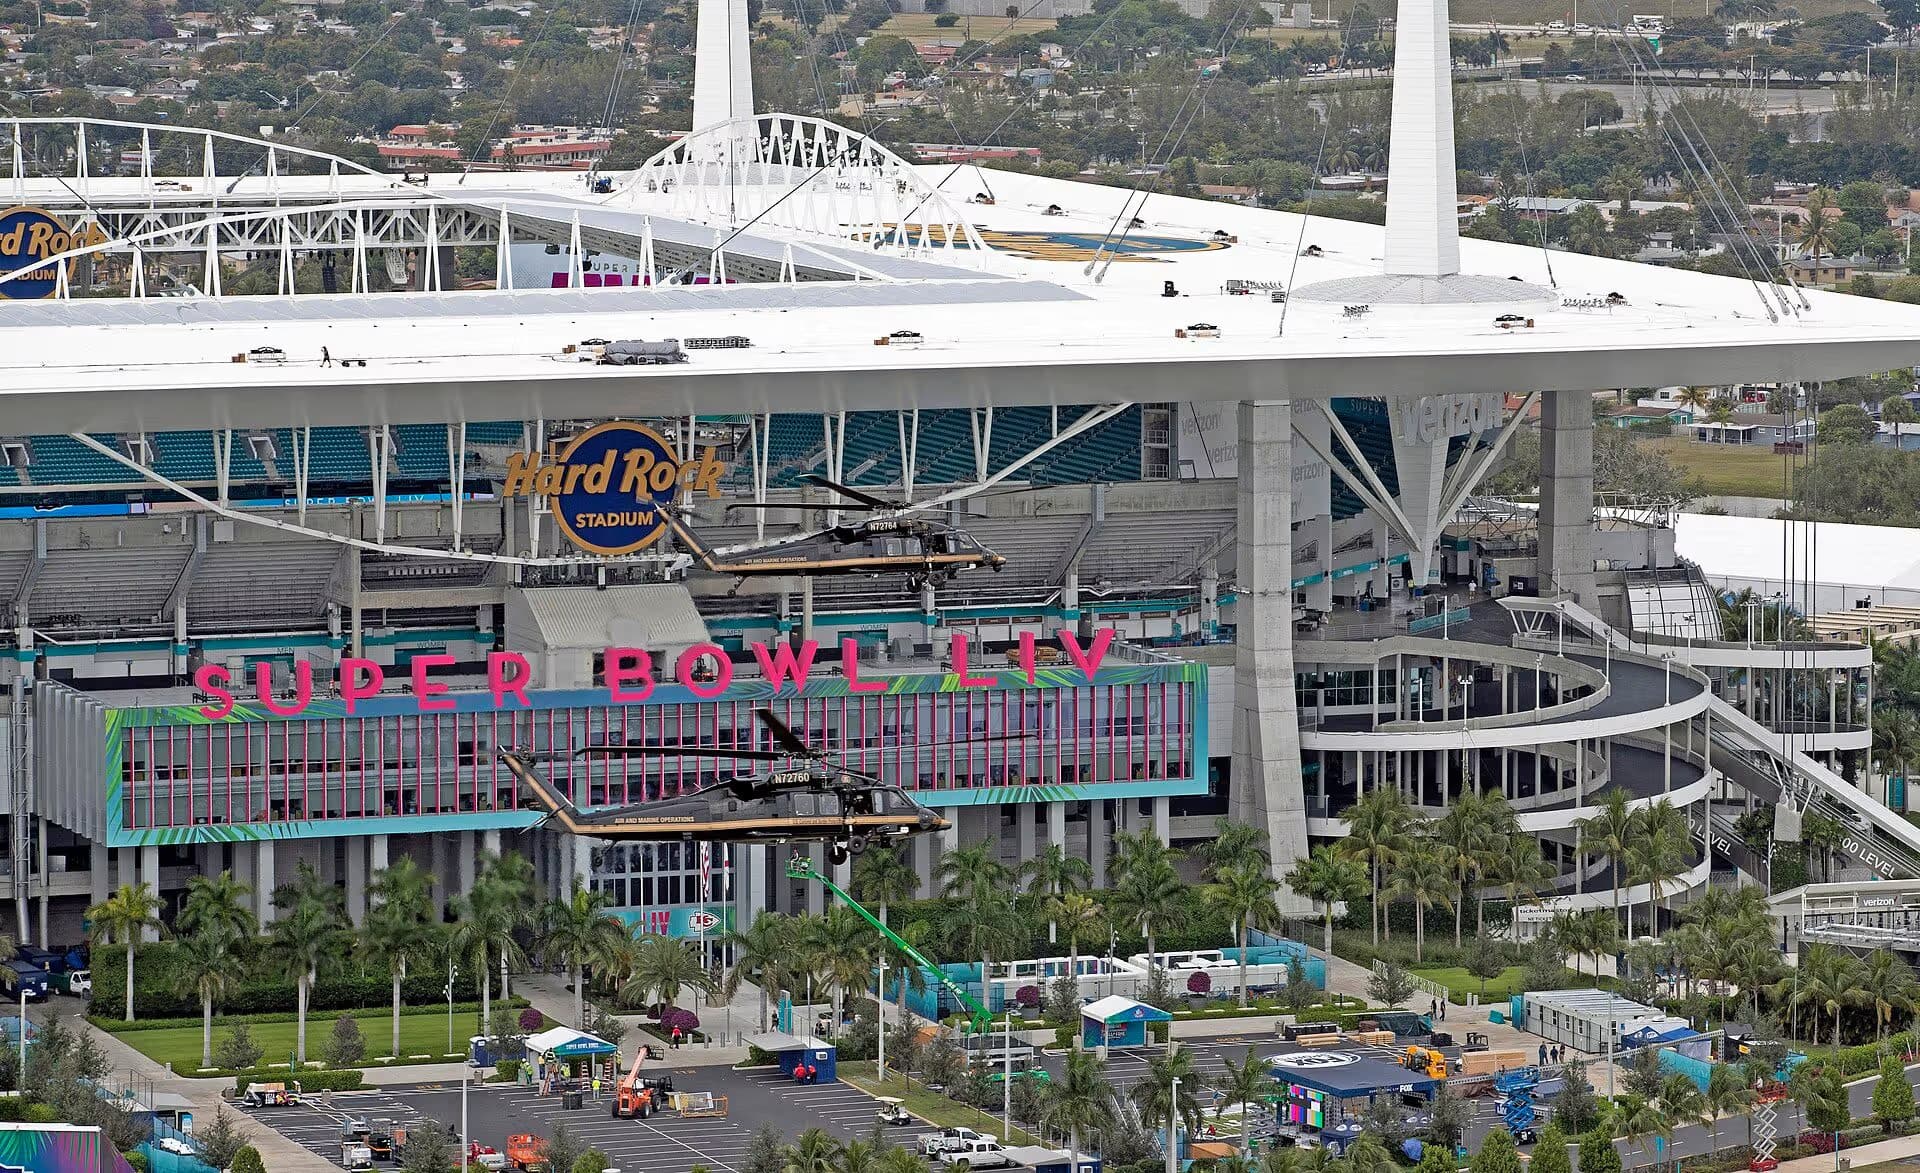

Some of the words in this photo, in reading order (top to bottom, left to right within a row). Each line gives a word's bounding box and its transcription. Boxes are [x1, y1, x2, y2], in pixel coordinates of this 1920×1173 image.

[1181, 412, 1219, 435] verizon
[1209, 442, 1238, 464] verizo
[503, 449, 618, 497] Hard
[619, 447, 726, 501] Rock
[575, 511, 653, 529] STADIUM
[870, 521, 897, 532] N72764
[860, 623, 889, 632] WOMEN
[416, 640, 449, 648] WOMEN
[194, 649, 532, 720] SUPER
[602, 637, 889, 702] BOWL
[951, 627, 1117, 688] LIV
[774, 772, 810, 784] N72760
[1840, 836, 1858, 854] 00
[1858, 847, 1897, 880] LEVEL
[1863, 898, 1895, 907] verizon
[1399, 1083, 1413, 1093] FOX
